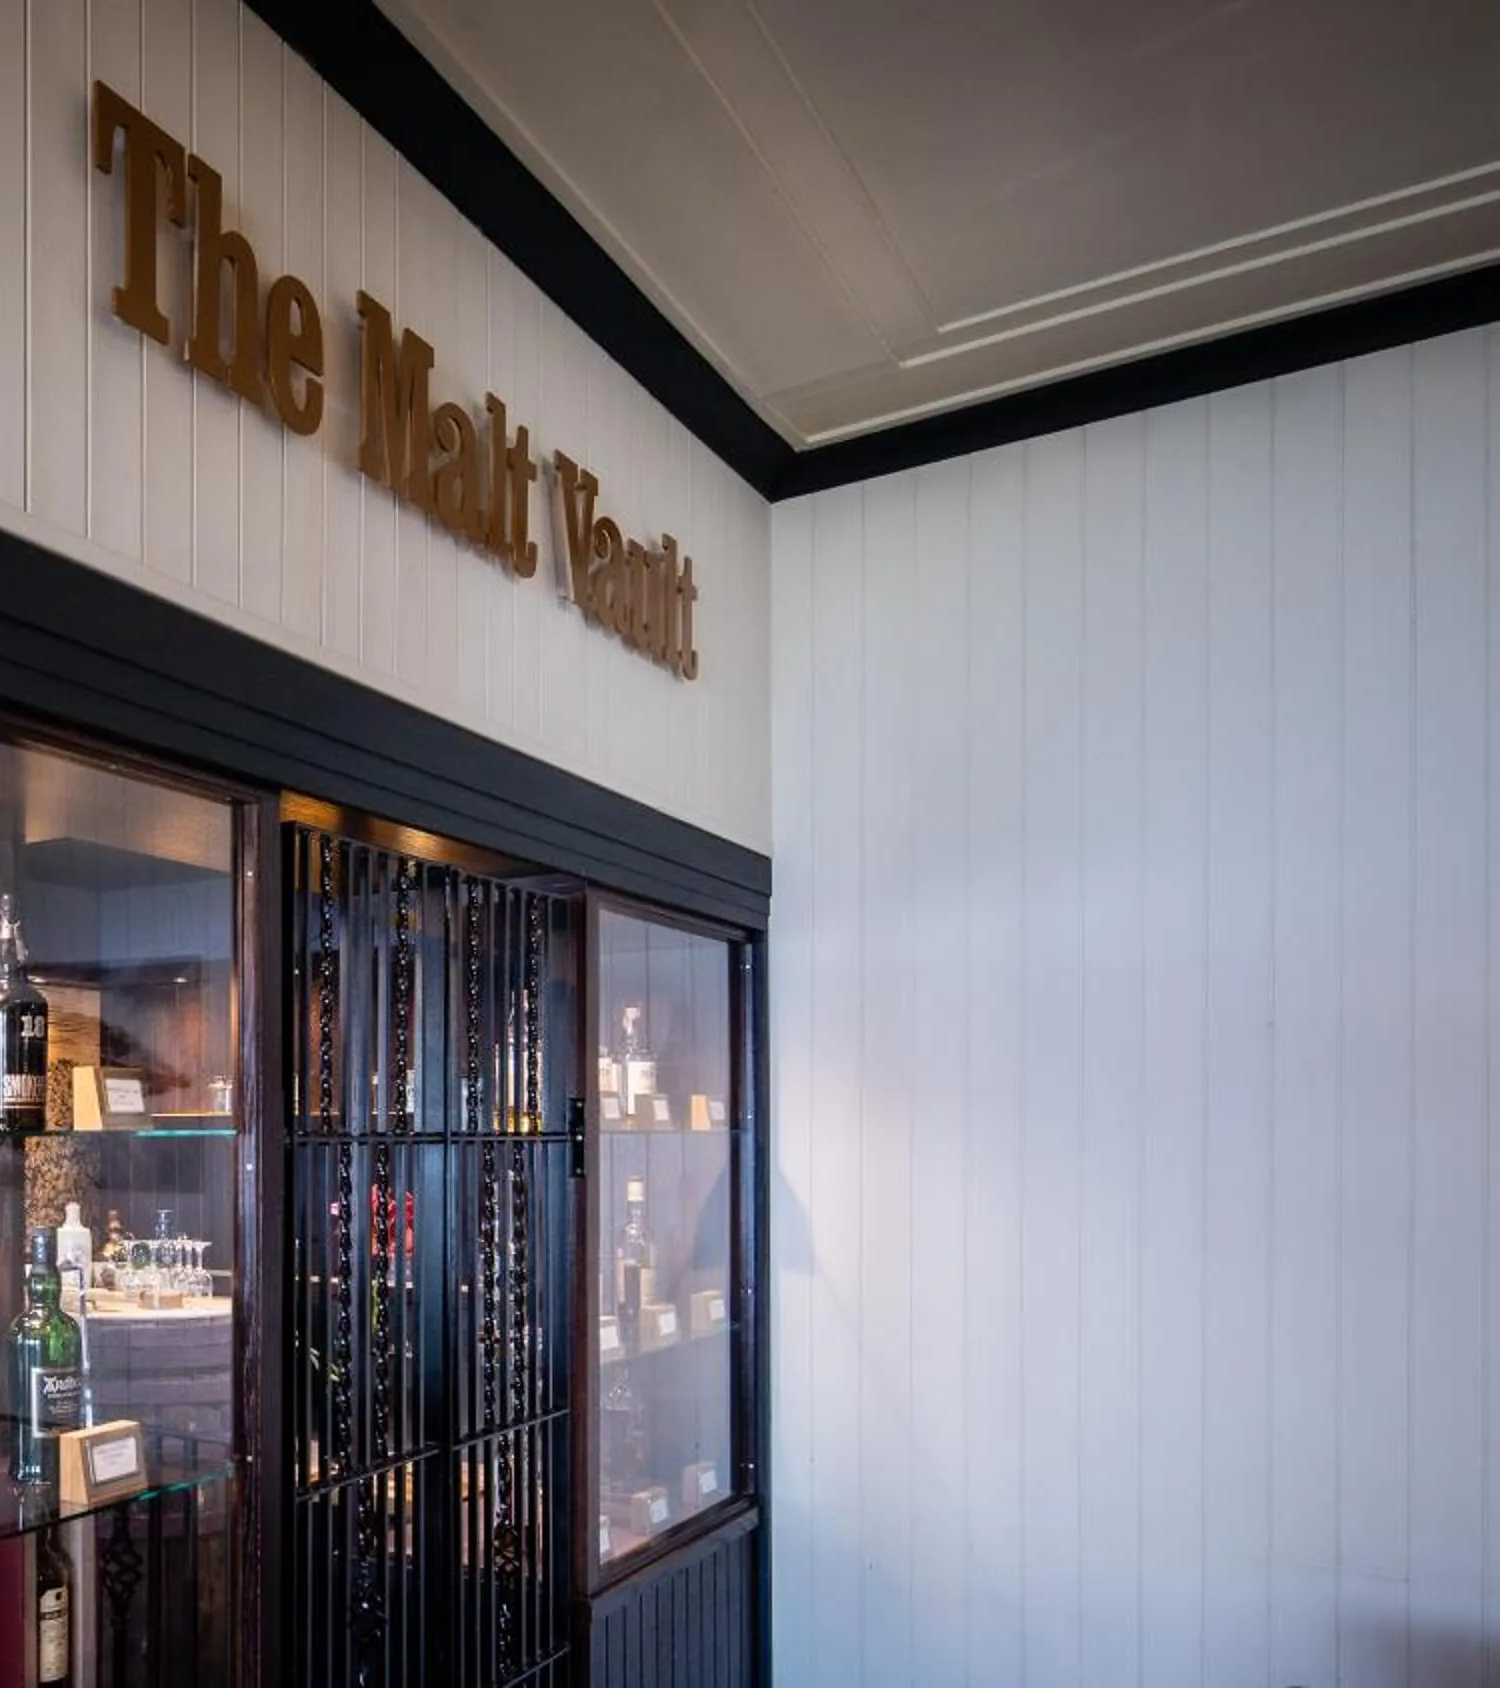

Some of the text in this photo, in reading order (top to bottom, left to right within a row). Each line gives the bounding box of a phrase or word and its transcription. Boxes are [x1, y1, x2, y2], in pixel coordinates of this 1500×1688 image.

[93, 79, 699, 682] The Malt Vault
